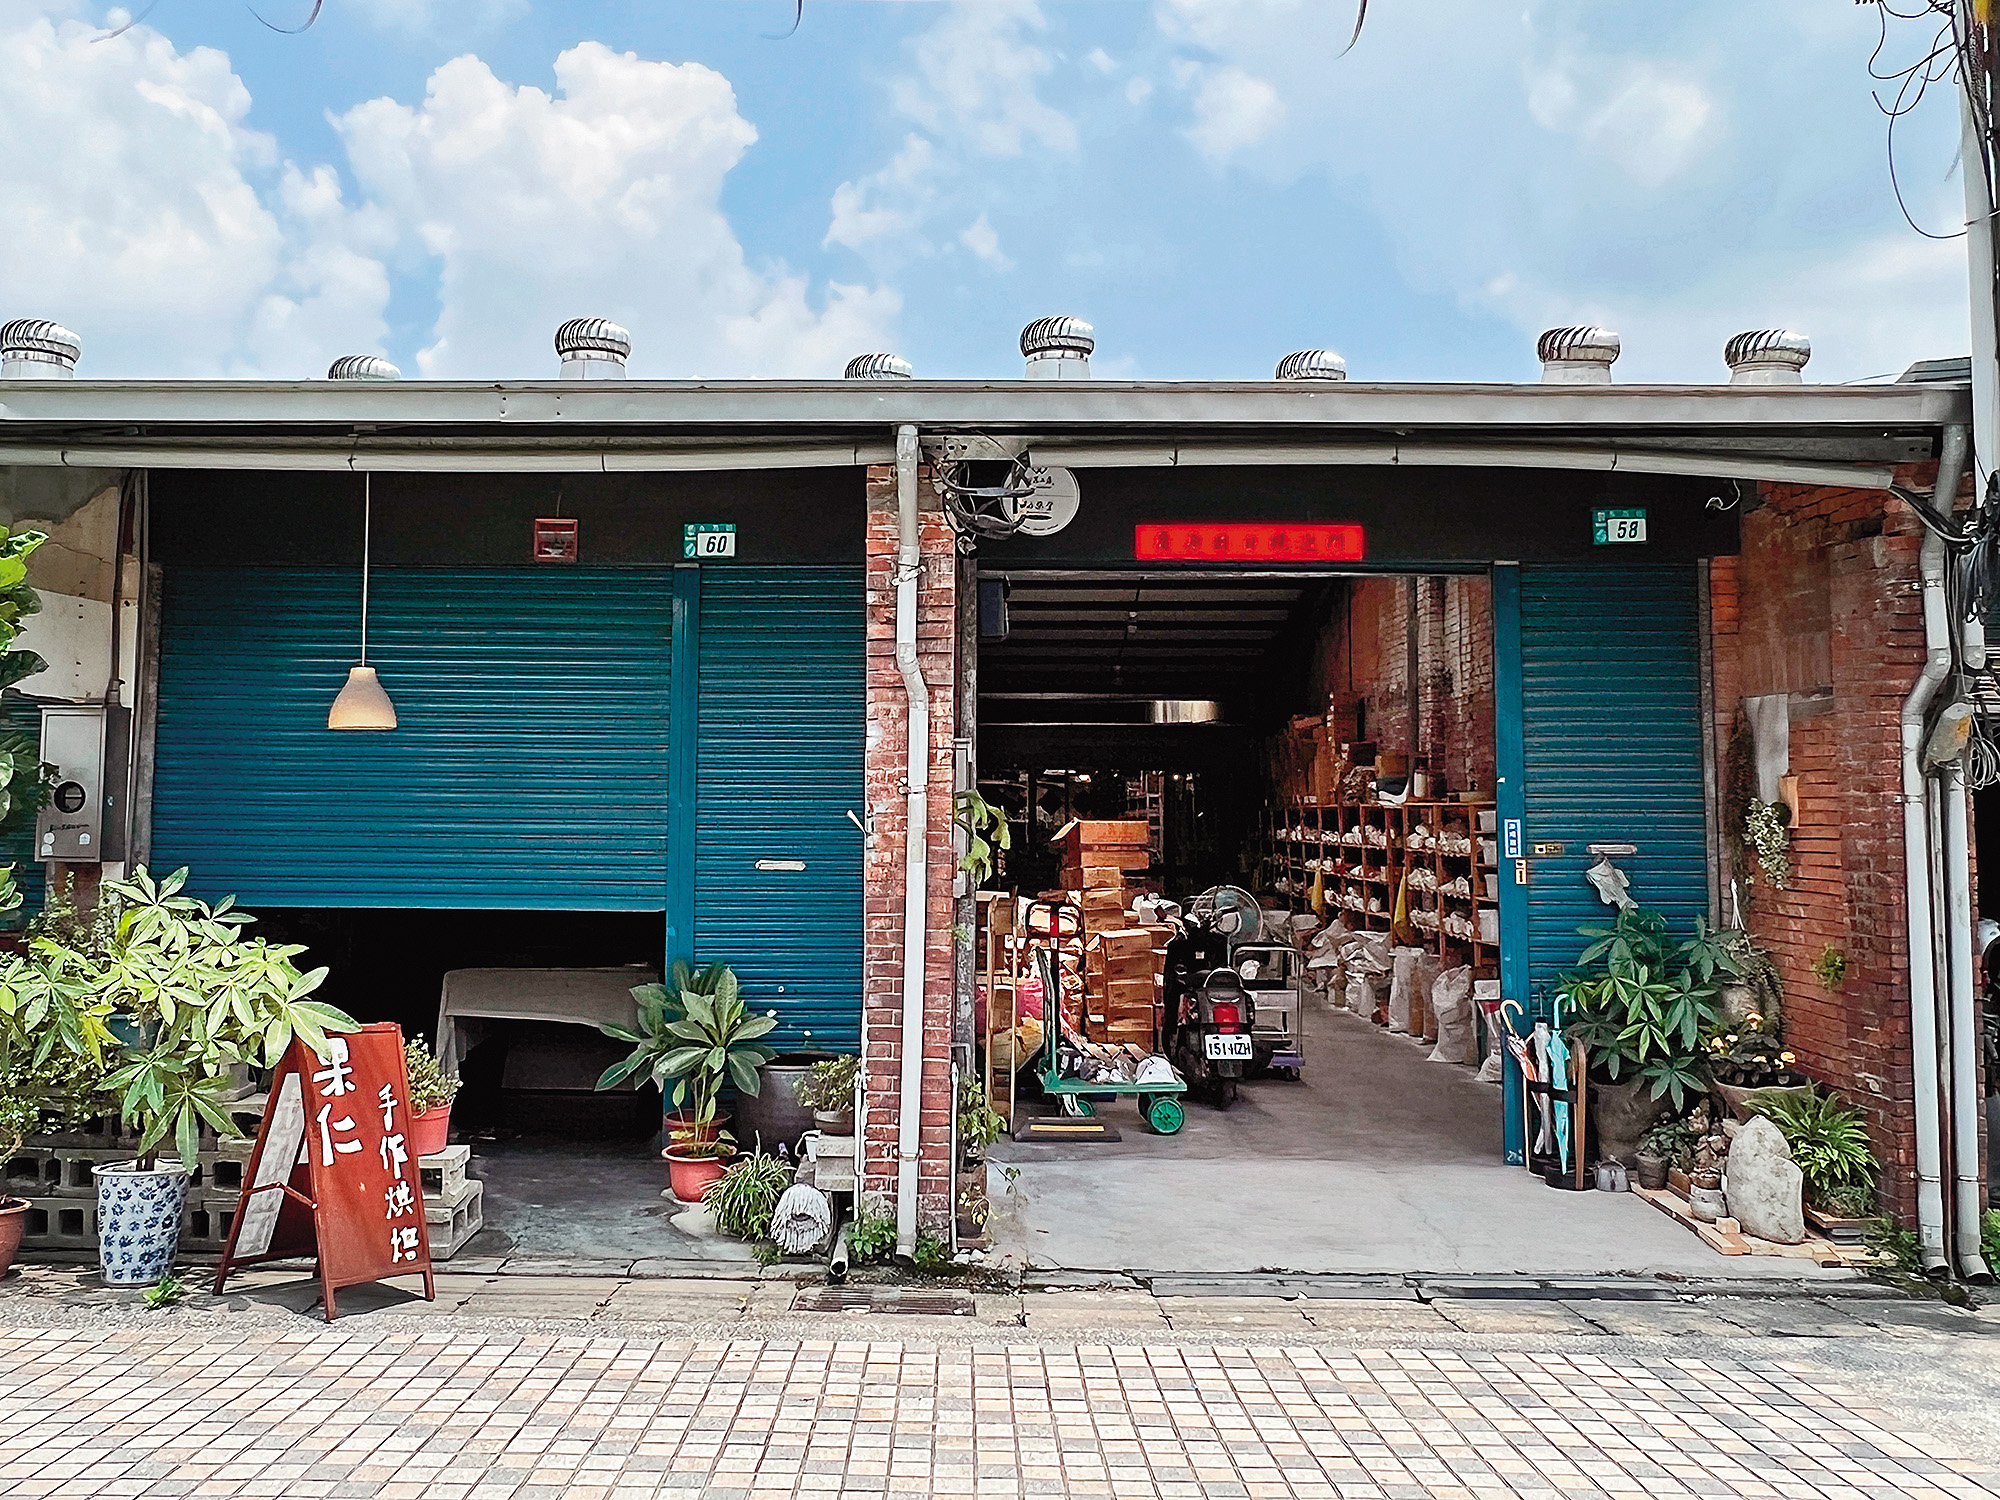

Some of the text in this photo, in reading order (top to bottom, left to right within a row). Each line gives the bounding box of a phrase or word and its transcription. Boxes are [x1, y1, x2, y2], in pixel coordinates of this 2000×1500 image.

[706, 535, 728, 553] 60
[1617, 520, 1639, 539] 58
[312, 1037, 363, 1167] 果仁
[378, 1083, 420, 1264] 手作烘焙
